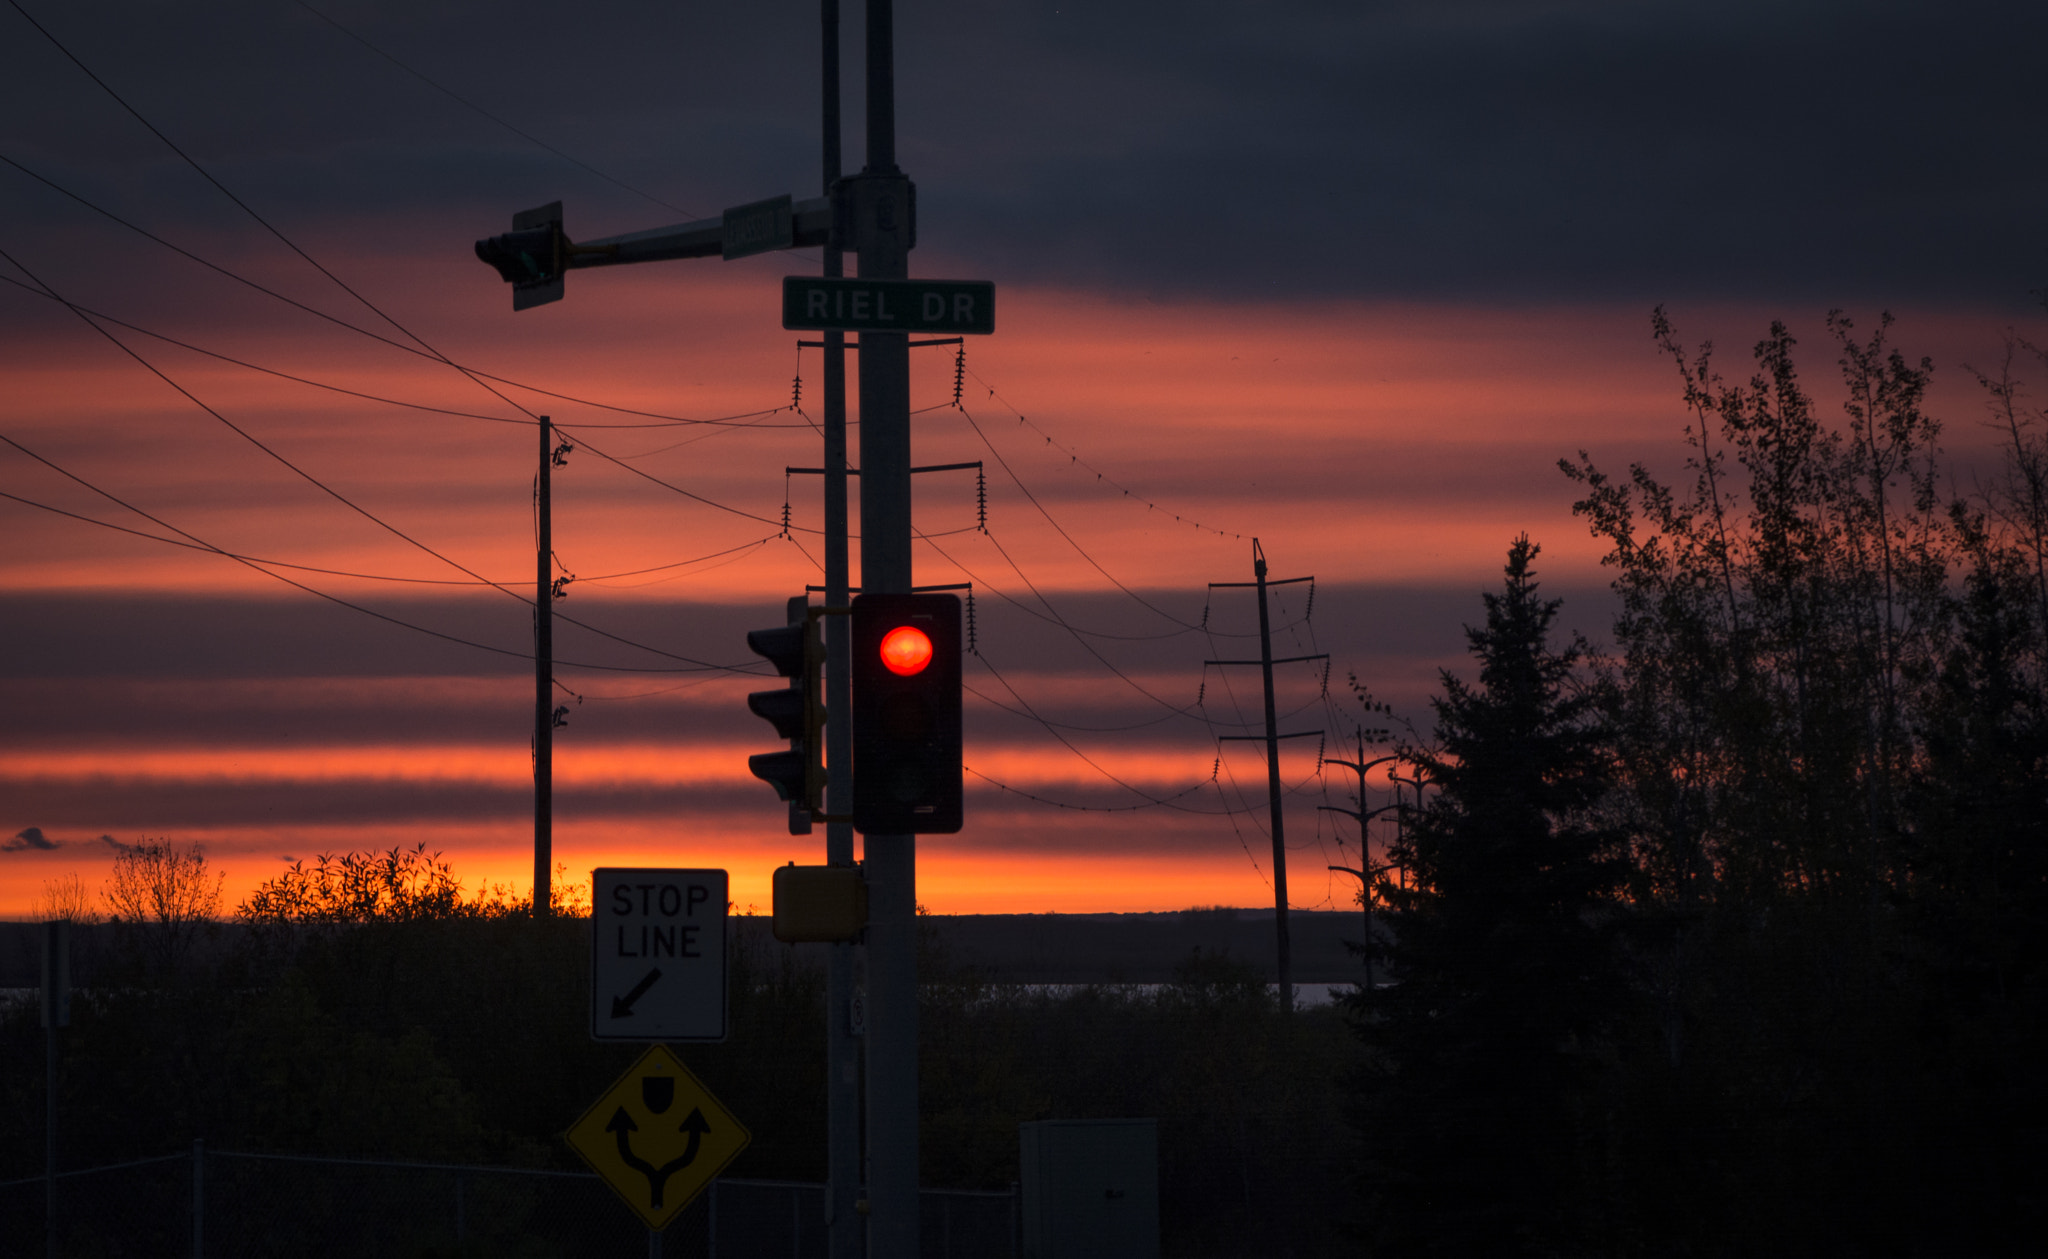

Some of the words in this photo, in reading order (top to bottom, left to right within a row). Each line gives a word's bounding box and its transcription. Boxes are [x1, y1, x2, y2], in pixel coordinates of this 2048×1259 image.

[806, 288, 895, 321] RIEL
[922, 291, 975, 323] DR
[612, 884, 708, 916] STOP
[618, 926, 701, 957] LINE
